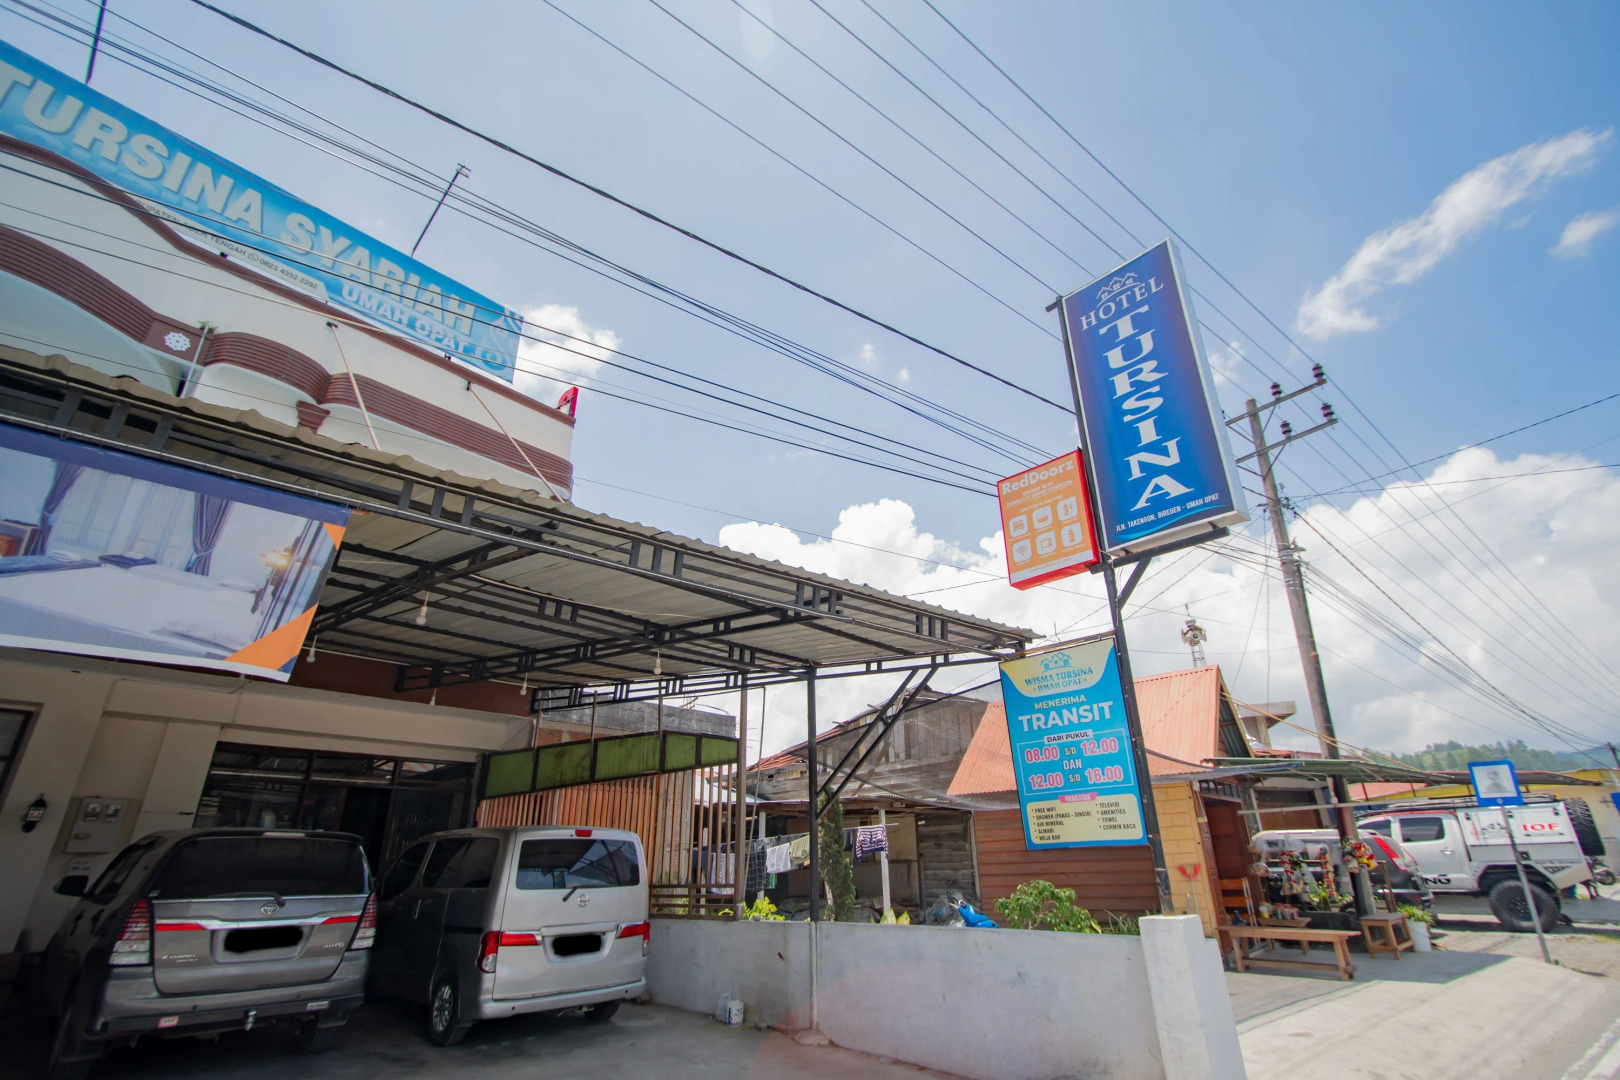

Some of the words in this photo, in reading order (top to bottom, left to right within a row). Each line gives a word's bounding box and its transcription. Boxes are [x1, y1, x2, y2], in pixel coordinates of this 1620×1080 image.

[259, 257, 278, 272] 0823
[280, 267, 298, 281] 4352
[299, 275, 318, 290] 2292
[280, 212, 477, 337] SYARIAH
[1079, 276, 1164, 331] HOTEL
[341, 282, 410, 329] UMAH
[415, 316, 468, 354] OPAT
[1099, 304, 1194, 511] TURSINA
[1002, 460, 1075, 495] RedDoorz
[1157, 505, 1181, 519] BIREUEN
[1186, 497, 1204, 509] UMAH
[1204, 492, 1219, 503] OPAT
[1024, 673, 1054, 686] WISMA
[1056, 666, 1093, 681] TURSINA
[1037, 682, 1060, 692] UMAH
[1061, 678, 1082, 688] OPAT
[1034, 694, 1087, 711] MENERIMA
[1018, 701, 1114, 732] TRANSIT
[1025, 745, 1060, 764] 08.00
[1064, 746, 1076, 756] S/D
[1080, 737, 1119, 757] 12.00
[1046, 734, 1064, 743] DARI
[1065, 731, 1090, 741] PUKUL
[1029, 772, 1064, 791] 12.00
[1068, 773, 1081, 783] S/D
[1084, 764, 1124, 784] 16.00
[1062, 758, 1082, 770] DAN
[1064, 793, 1091, 802] FASILITAS
[1100, 808, 1126, 816] AMENITIES
[1522, 822, 1560, 832] IOF
